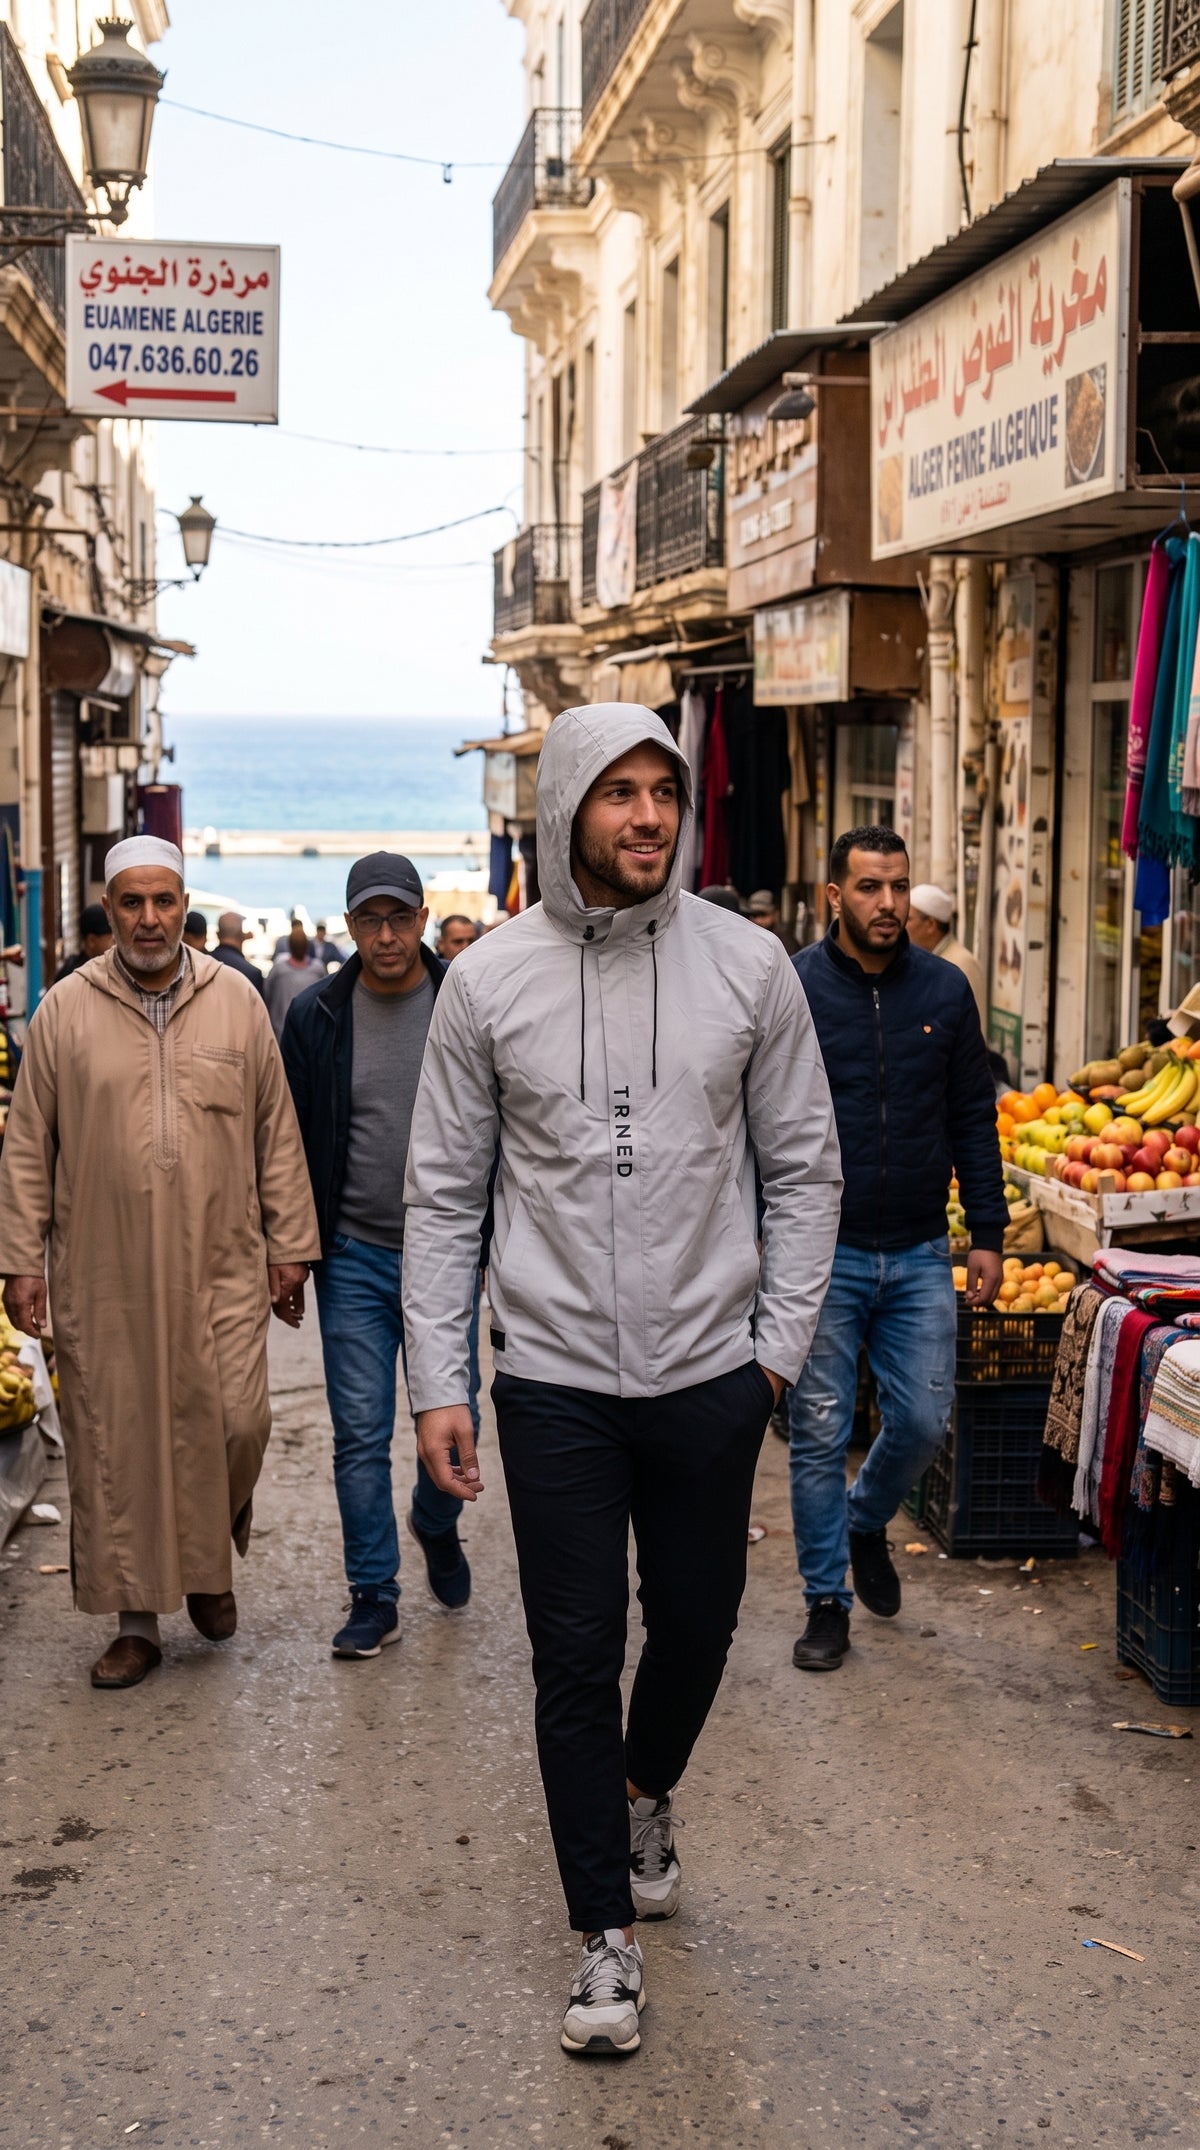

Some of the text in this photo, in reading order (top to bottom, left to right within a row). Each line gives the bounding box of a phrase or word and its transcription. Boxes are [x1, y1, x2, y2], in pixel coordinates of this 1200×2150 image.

[79, 255, 178, 298] الجنوي
[84, 304, 264, 336] EUAMENE ALGERIE
[88, 343, 259, 377] 047.636.60.26
[908, 394, 1058, 500] ALGER FENRE ALGEIQUE
[613, 1085, 633, 1178] TRNED
